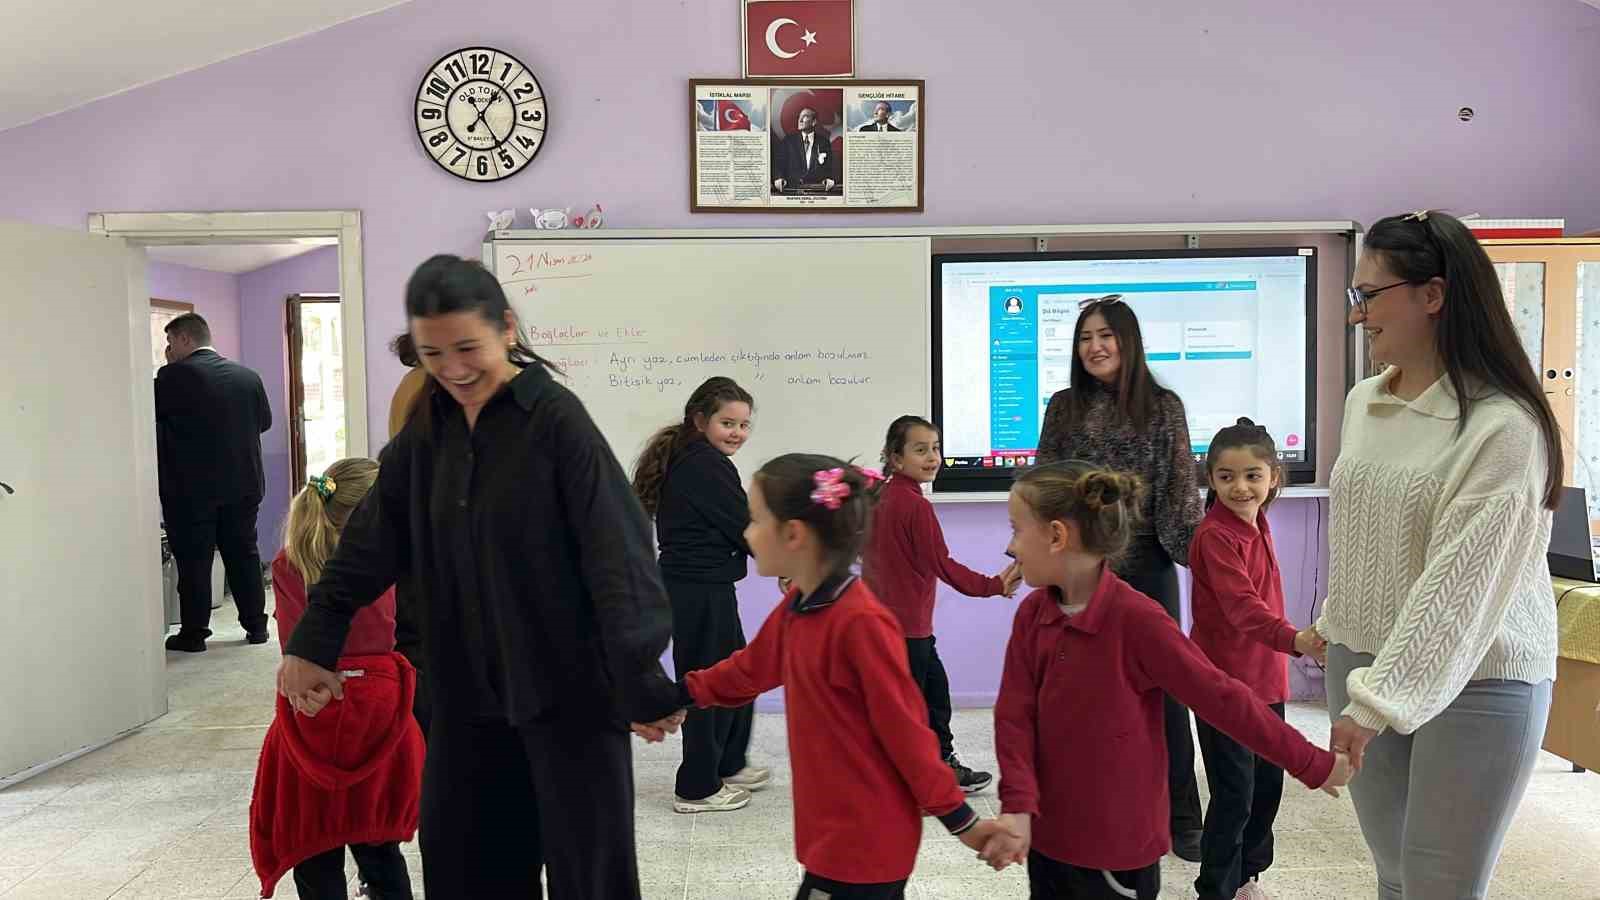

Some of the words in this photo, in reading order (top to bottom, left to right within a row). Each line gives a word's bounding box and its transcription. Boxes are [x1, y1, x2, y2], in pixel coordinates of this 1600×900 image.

[444, 59, 466, 82] 11
[469, 54, 490, 74] 12
[500, 62, 513, 81] 1
[426, 77, 451, 100] 10
[514, 82, 534, 100] 2
[421, 108, 442, 120] 9
[521, 110, 542, 122] 3
[429, 131, 449, 148] 8
[515, 135, 535, 150] 4
[449, 146, 467, 166] 7
[476, 155, 488, 176] 6
[498, 148, 515, 169] 5
[505, 252, 534, 276] 21
